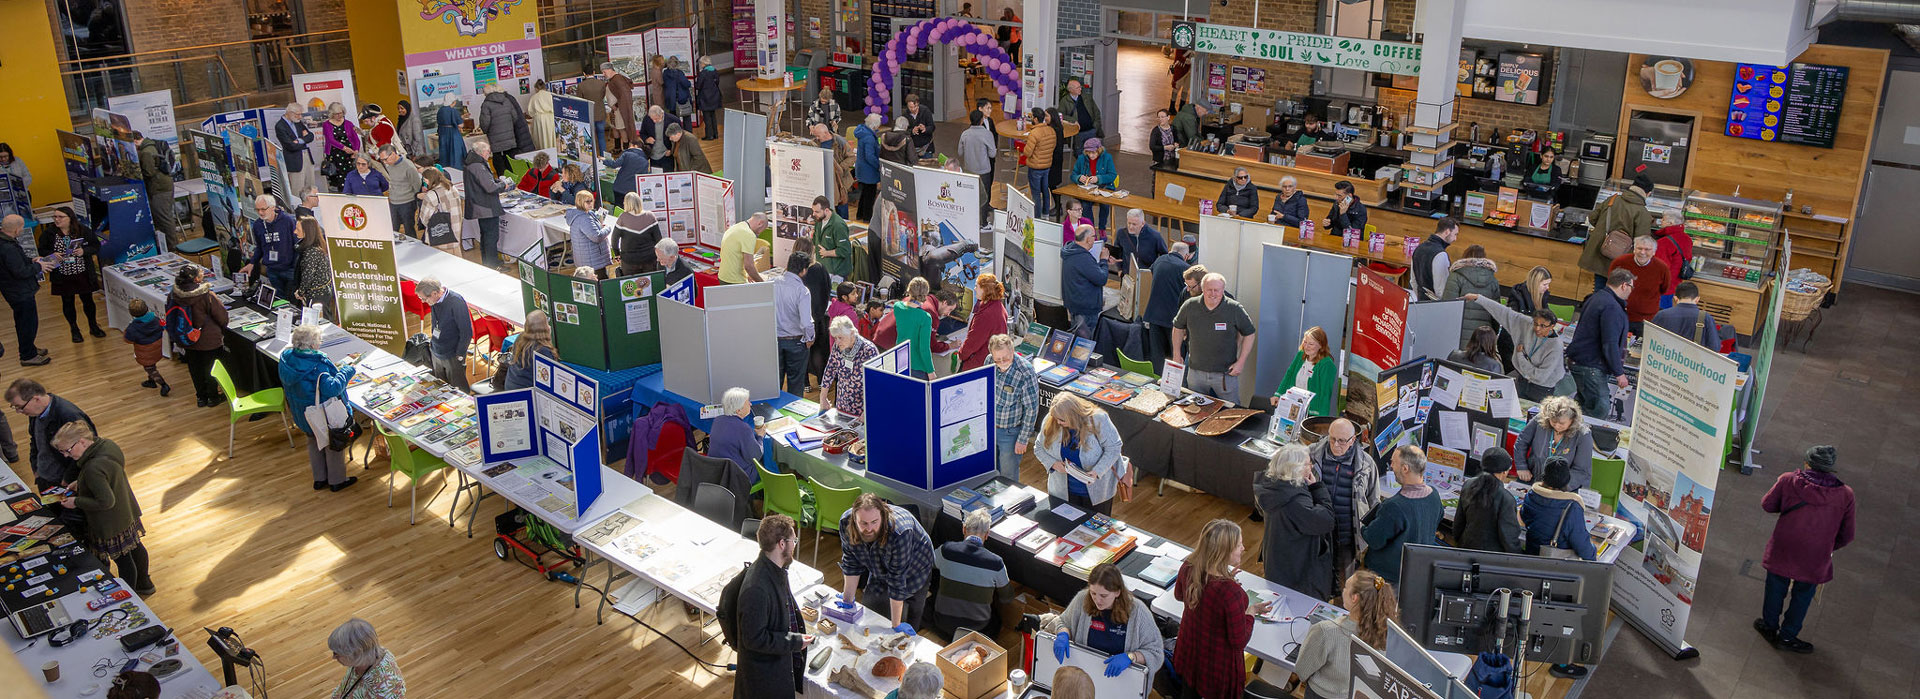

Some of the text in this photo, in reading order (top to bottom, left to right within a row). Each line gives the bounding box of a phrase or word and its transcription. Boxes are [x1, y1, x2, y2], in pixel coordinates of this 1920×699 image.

[1200, 27, 1248, 41] HEART
[1286, 35, 1333, 49] PRIDE
[1373, 43, 1422, 61] COFFEE
[445, 43, 506, 60] WHAT'S ON
[1260, 44, 1370, 68] SOUL Love
[1500, 68, 1539, 77] DELICIOUS
[927, 199, 965, 213] BOSWORTH
[335, 239, 384, 250] WELCOME
[347, 260, 378, 271] To The
[334, 270, 396, 282] Leicestershire
[339, 281, 393, 292] And Rutland
[337, 291, 399, 304] Family History
[352, 302, 385, 314] Society
[1649, 338, 1727, 385] Neighbourhood
[1646, 354, 1690, 384] Services
